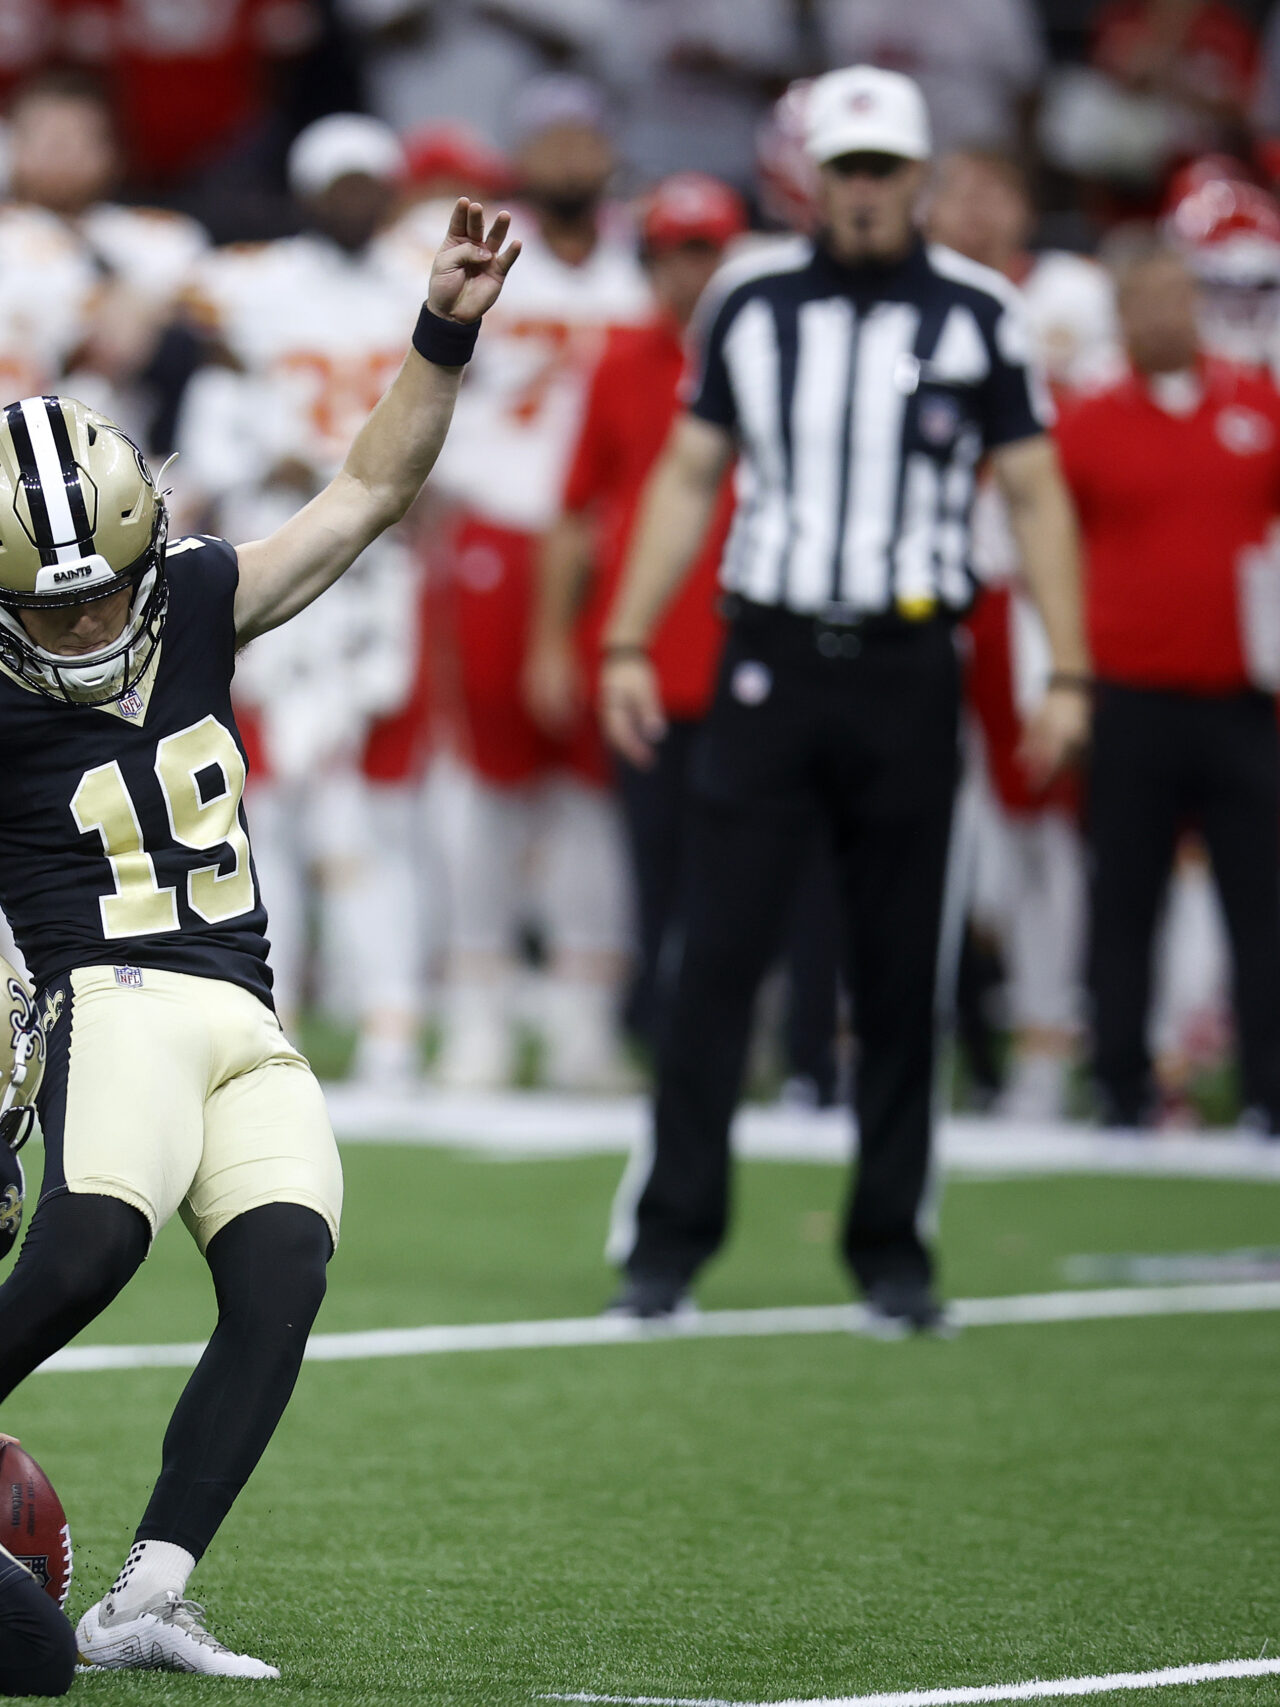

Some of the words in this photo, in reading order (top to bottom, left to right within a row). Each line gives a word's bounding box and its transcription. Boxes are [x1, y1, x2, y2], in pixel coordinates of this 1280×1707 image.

[53, 565, 92, 583] SAINTS
[121, 697, 141, 713] NFL
[69, 713, 255, 940] 19
[120, 974, 140, 984] NFL
